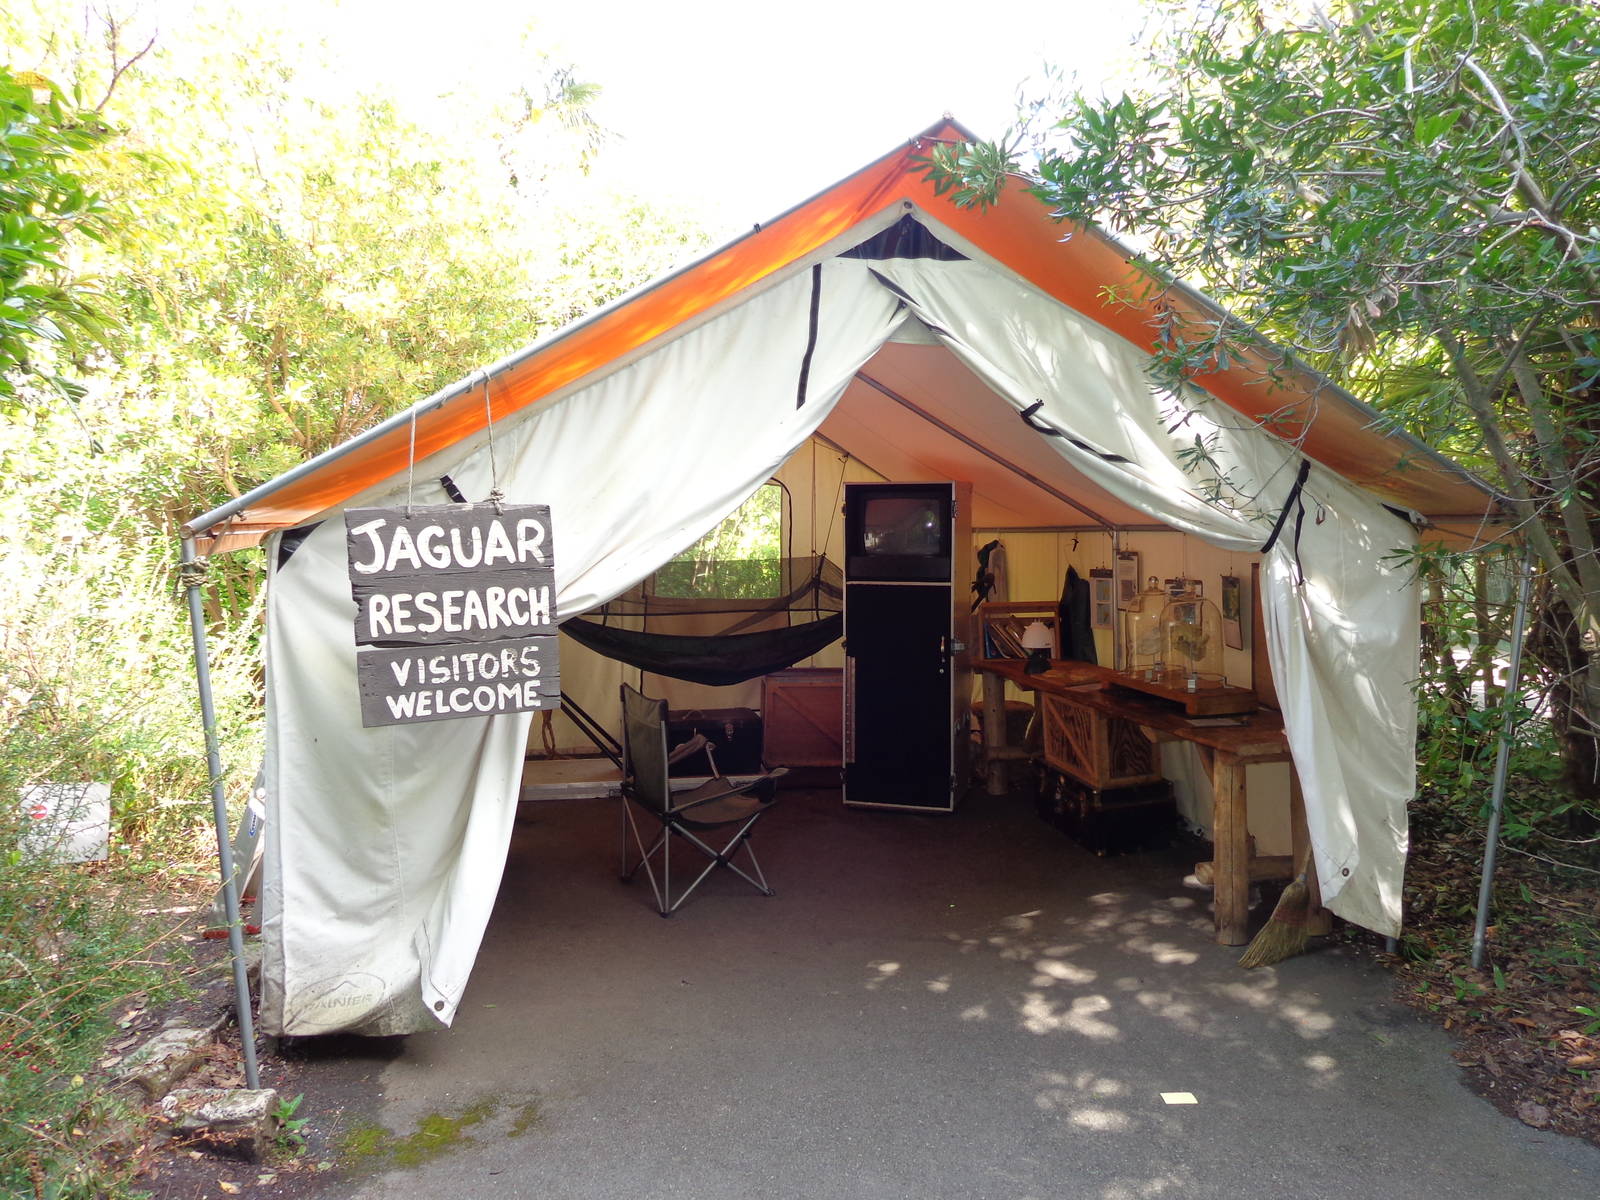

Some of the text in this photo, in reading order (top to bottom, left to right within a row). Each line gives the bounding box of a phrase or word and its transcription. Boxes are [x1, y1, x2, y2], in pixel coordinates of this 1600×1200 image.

[351, 518, 545, 574] JAGUAR
[368, 585, 550, 637] RESEARCH
[391, 646, 541, 687] VISITORS
[386, 680, 541, 719] WELCOME
